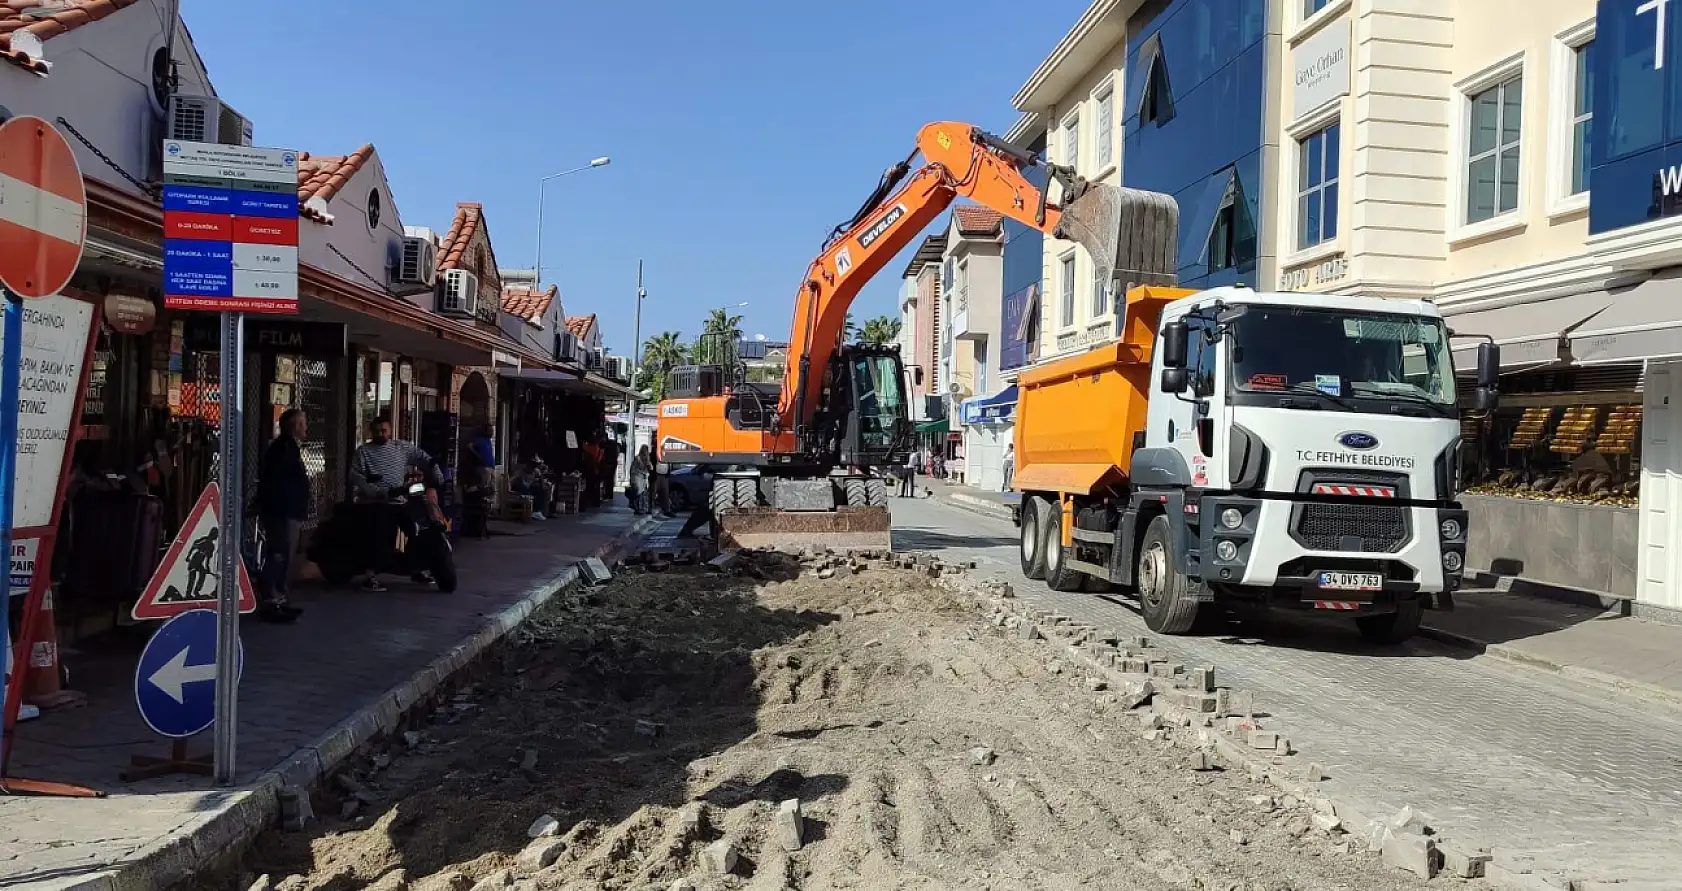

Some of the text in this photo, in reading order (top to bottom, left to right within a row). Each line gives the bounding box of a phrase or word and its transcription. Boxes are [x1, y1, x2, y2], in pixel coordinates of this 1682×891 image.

[863, 208, 901, 247] DEVELON
[22, 308, 66, 331] ERGAHINDA
[19, 357, 38, 374] APIM,
[40, 360, 62, 375] BAKIM
[65, 364, 75, 377] VE
[18, 375, 68, 393] ACAĞINDAN
[1347, 434, 1372, 445] Ford
[1316, 449, 1358, 465] FETHİYE
[1362, 453, 1415, 469] BELEDİYESİ
[10, 560, 35, 571] PAIR
[1326, 573, 1379, 587] 34 DVS 763
